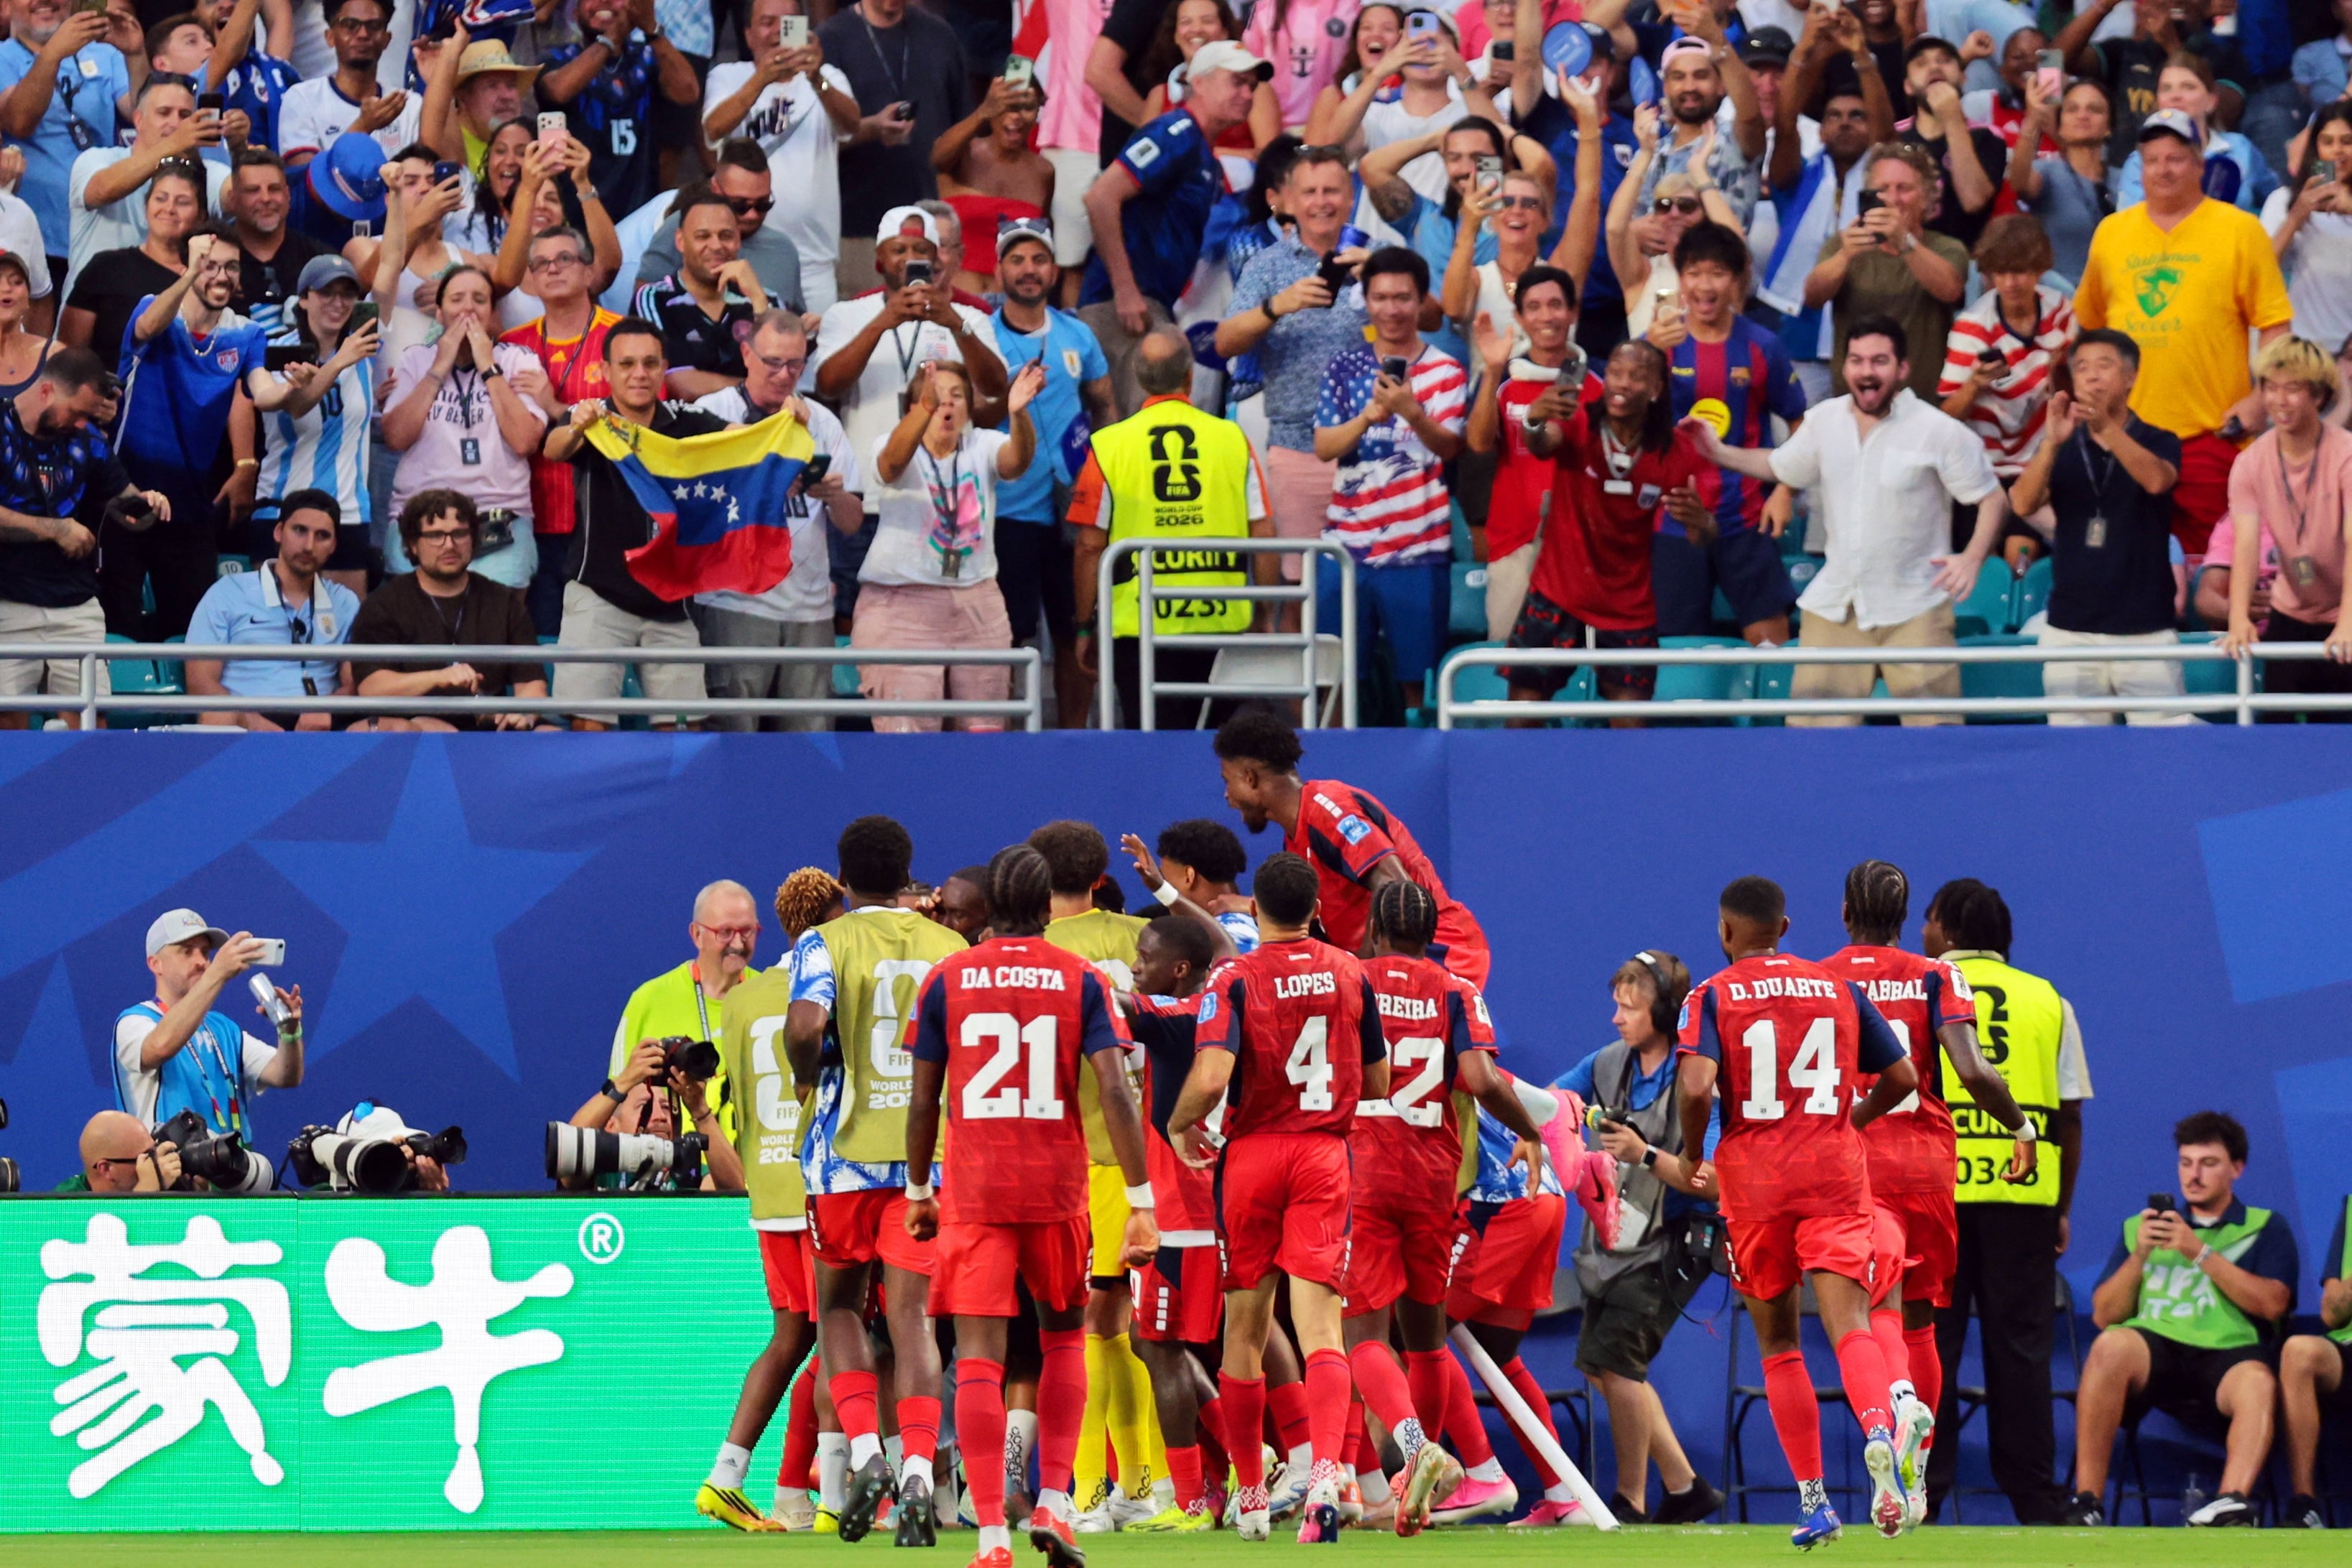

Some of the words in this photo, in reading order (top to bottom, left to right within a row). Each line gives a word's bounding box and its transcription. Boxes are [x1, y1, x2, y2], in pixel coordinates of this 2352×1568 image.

[609, 119, 637, 155] 15
[1166, 486, 1191, 496] FIFA
[1154, 514, 1204, 527] 2026
[225, 563, 239, 574] 10
[1131, 550, 1238, 572] CURITY
[960, 966, 992, 989] DA
[995, 966, 1065, 991] COSTA
[1274, 971, 1336, 999] LOPES
[1728, 983, 1752, 1001] D.
[1751, 976, 1838, 1000] DUARTE
[1375, 993, 1438, 1021] REIRA
[888, 1054, 913, 1067] FIF
[960, 1012, 1065, 1120] 21
[1284, 1015, 1333, 1111] 4
[1741, 1016, 1841, 1121] 14
[869, 1092, 914, 1110] 20
[37, 1212, 575, 1514] 蒙牛
